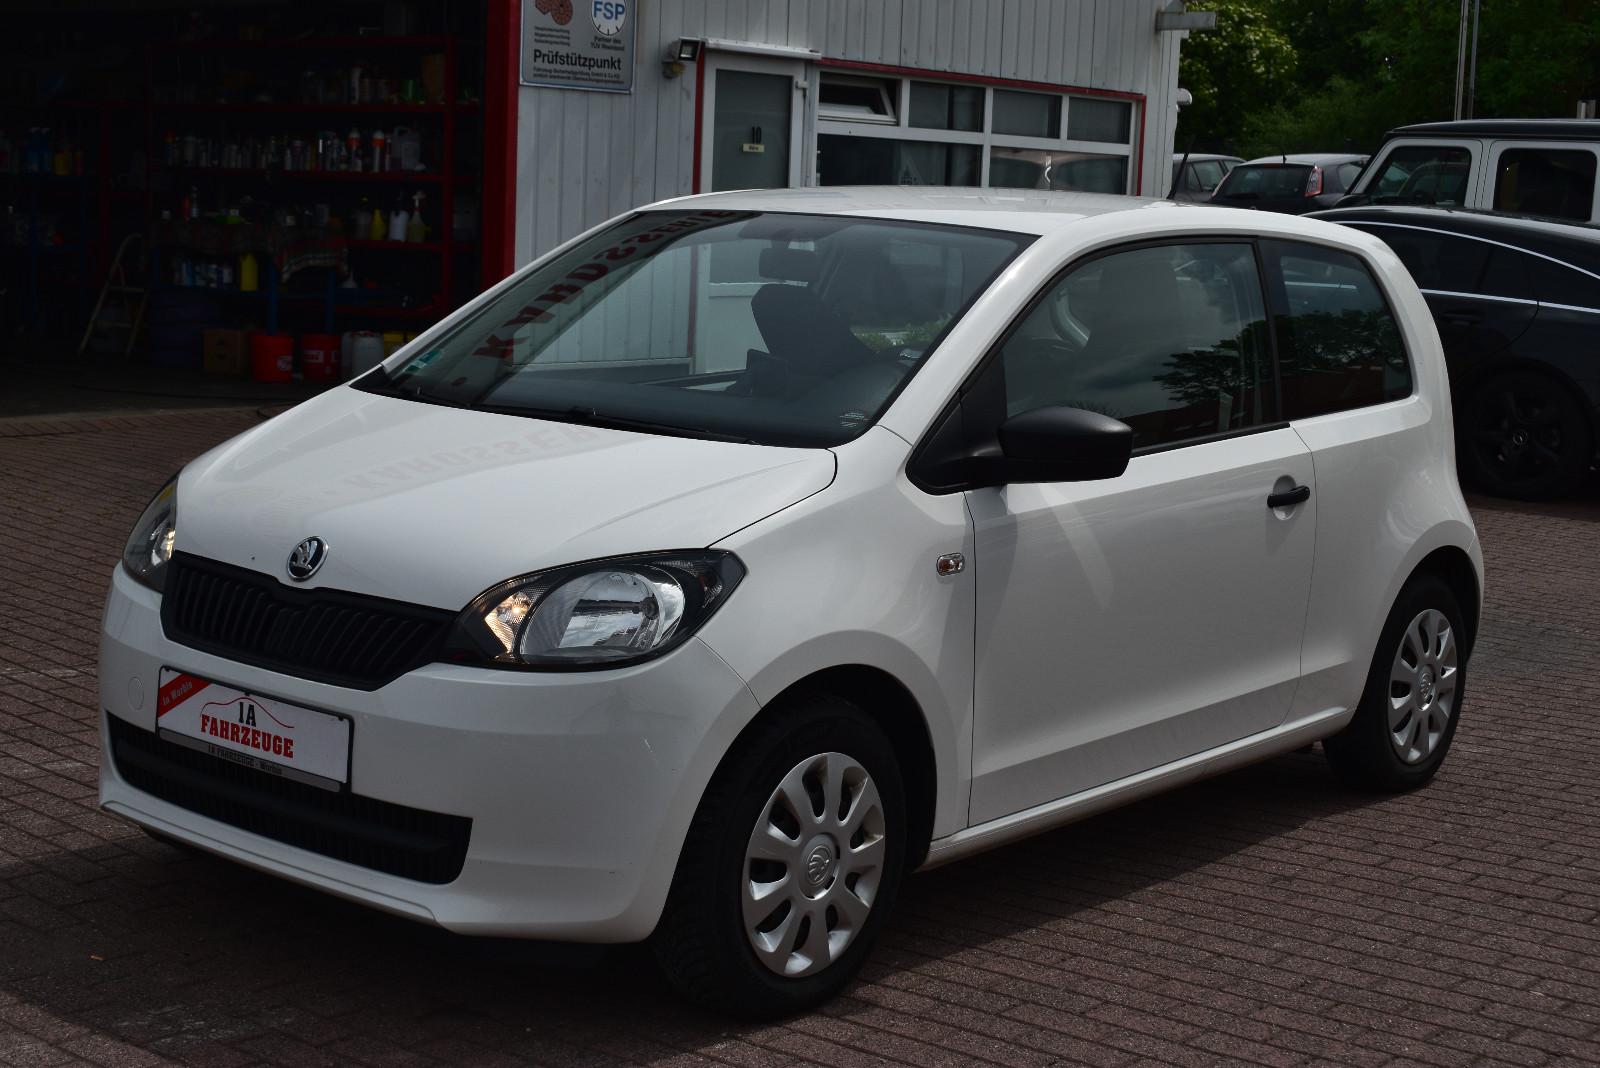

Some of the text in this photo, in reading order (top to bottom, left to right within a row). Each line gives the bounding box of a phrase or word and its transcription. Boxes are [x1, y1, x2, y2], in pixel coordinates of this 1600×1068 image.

[593, 1, 625, 20] FSP
[533, 49, 621, 70] Prüfstützpunkt
[201, 714, 294, 758] FAHRZEUGE
